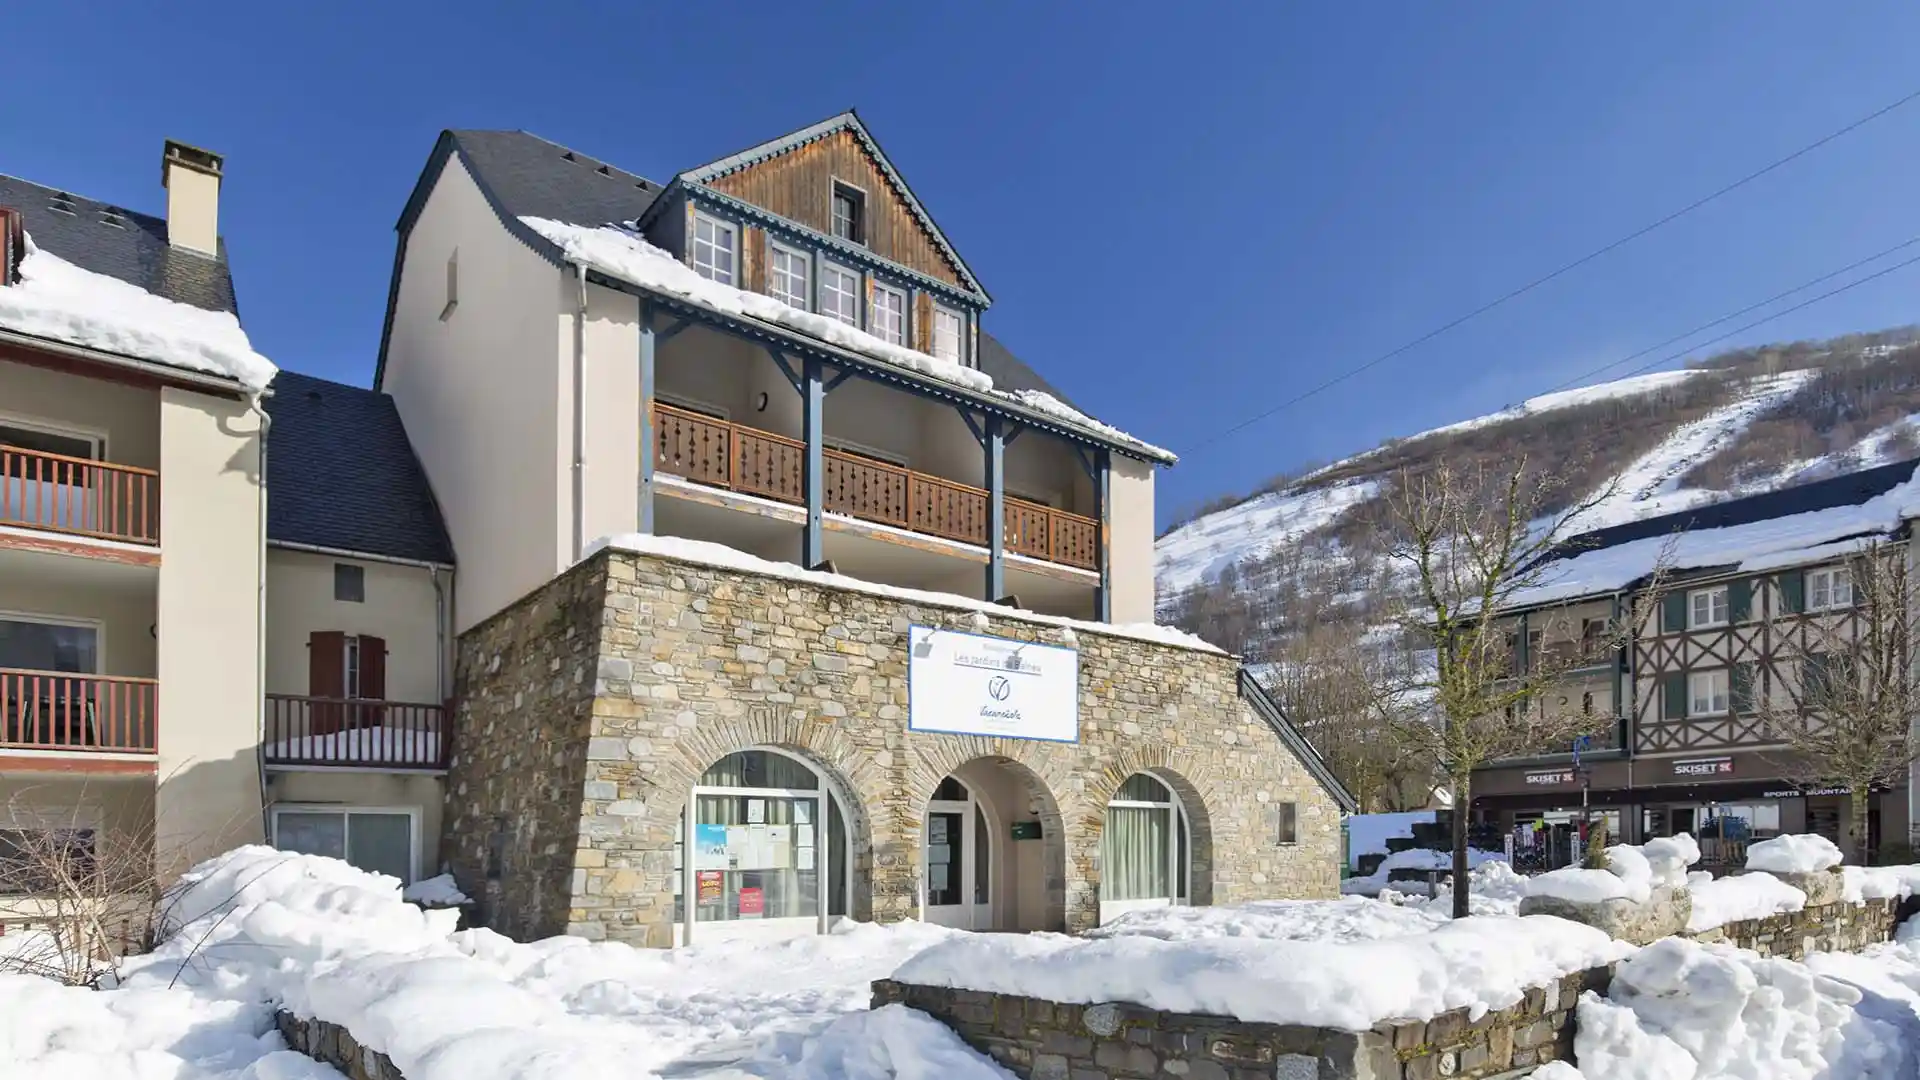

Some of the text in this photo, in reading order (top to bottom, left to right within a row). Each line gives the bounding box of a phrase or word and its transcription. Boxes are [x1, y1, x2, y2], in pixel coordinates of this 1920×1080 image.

[954, 651, 969, 663] Les
[1675, 764, 1717, 774] SKISET
[1526, 774, 1561, 783] SKISET
[1763, 787, 1855, 798] SPORTS MOUNTAI
